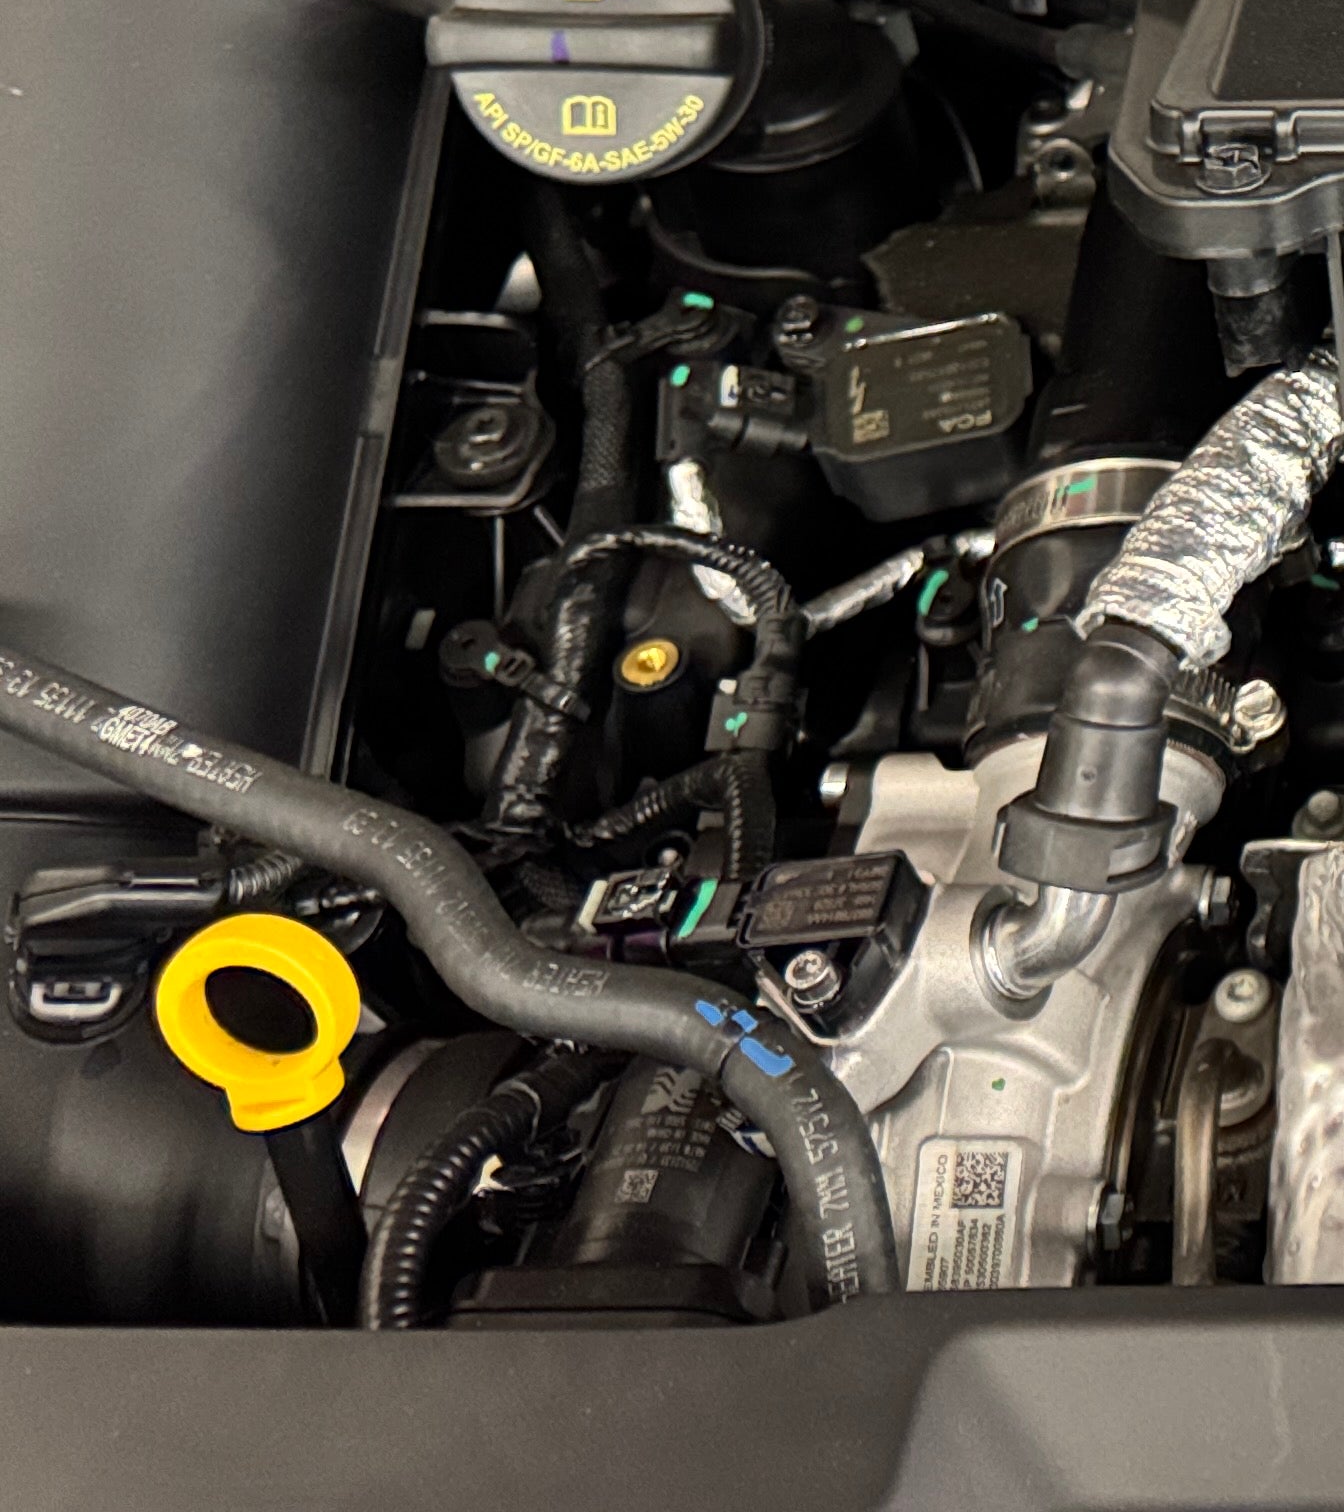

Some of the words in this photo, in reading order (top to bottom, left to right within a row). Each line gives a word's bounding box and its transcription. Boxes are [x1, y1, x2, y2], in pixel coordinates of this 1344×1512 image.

[473, 90, 506, 130] API
[937, 408, 993, 433] FCA
[33, 681, 95, 723] 11135
[521, 961, 610, 993] HEATER
[791, 1087, 838, 1165] 57512
[814, 1167, 850, 1219] 7MM
[931, 1153, 948, 1209] MEXICO
[930, 1214, 941, 1228] IN
